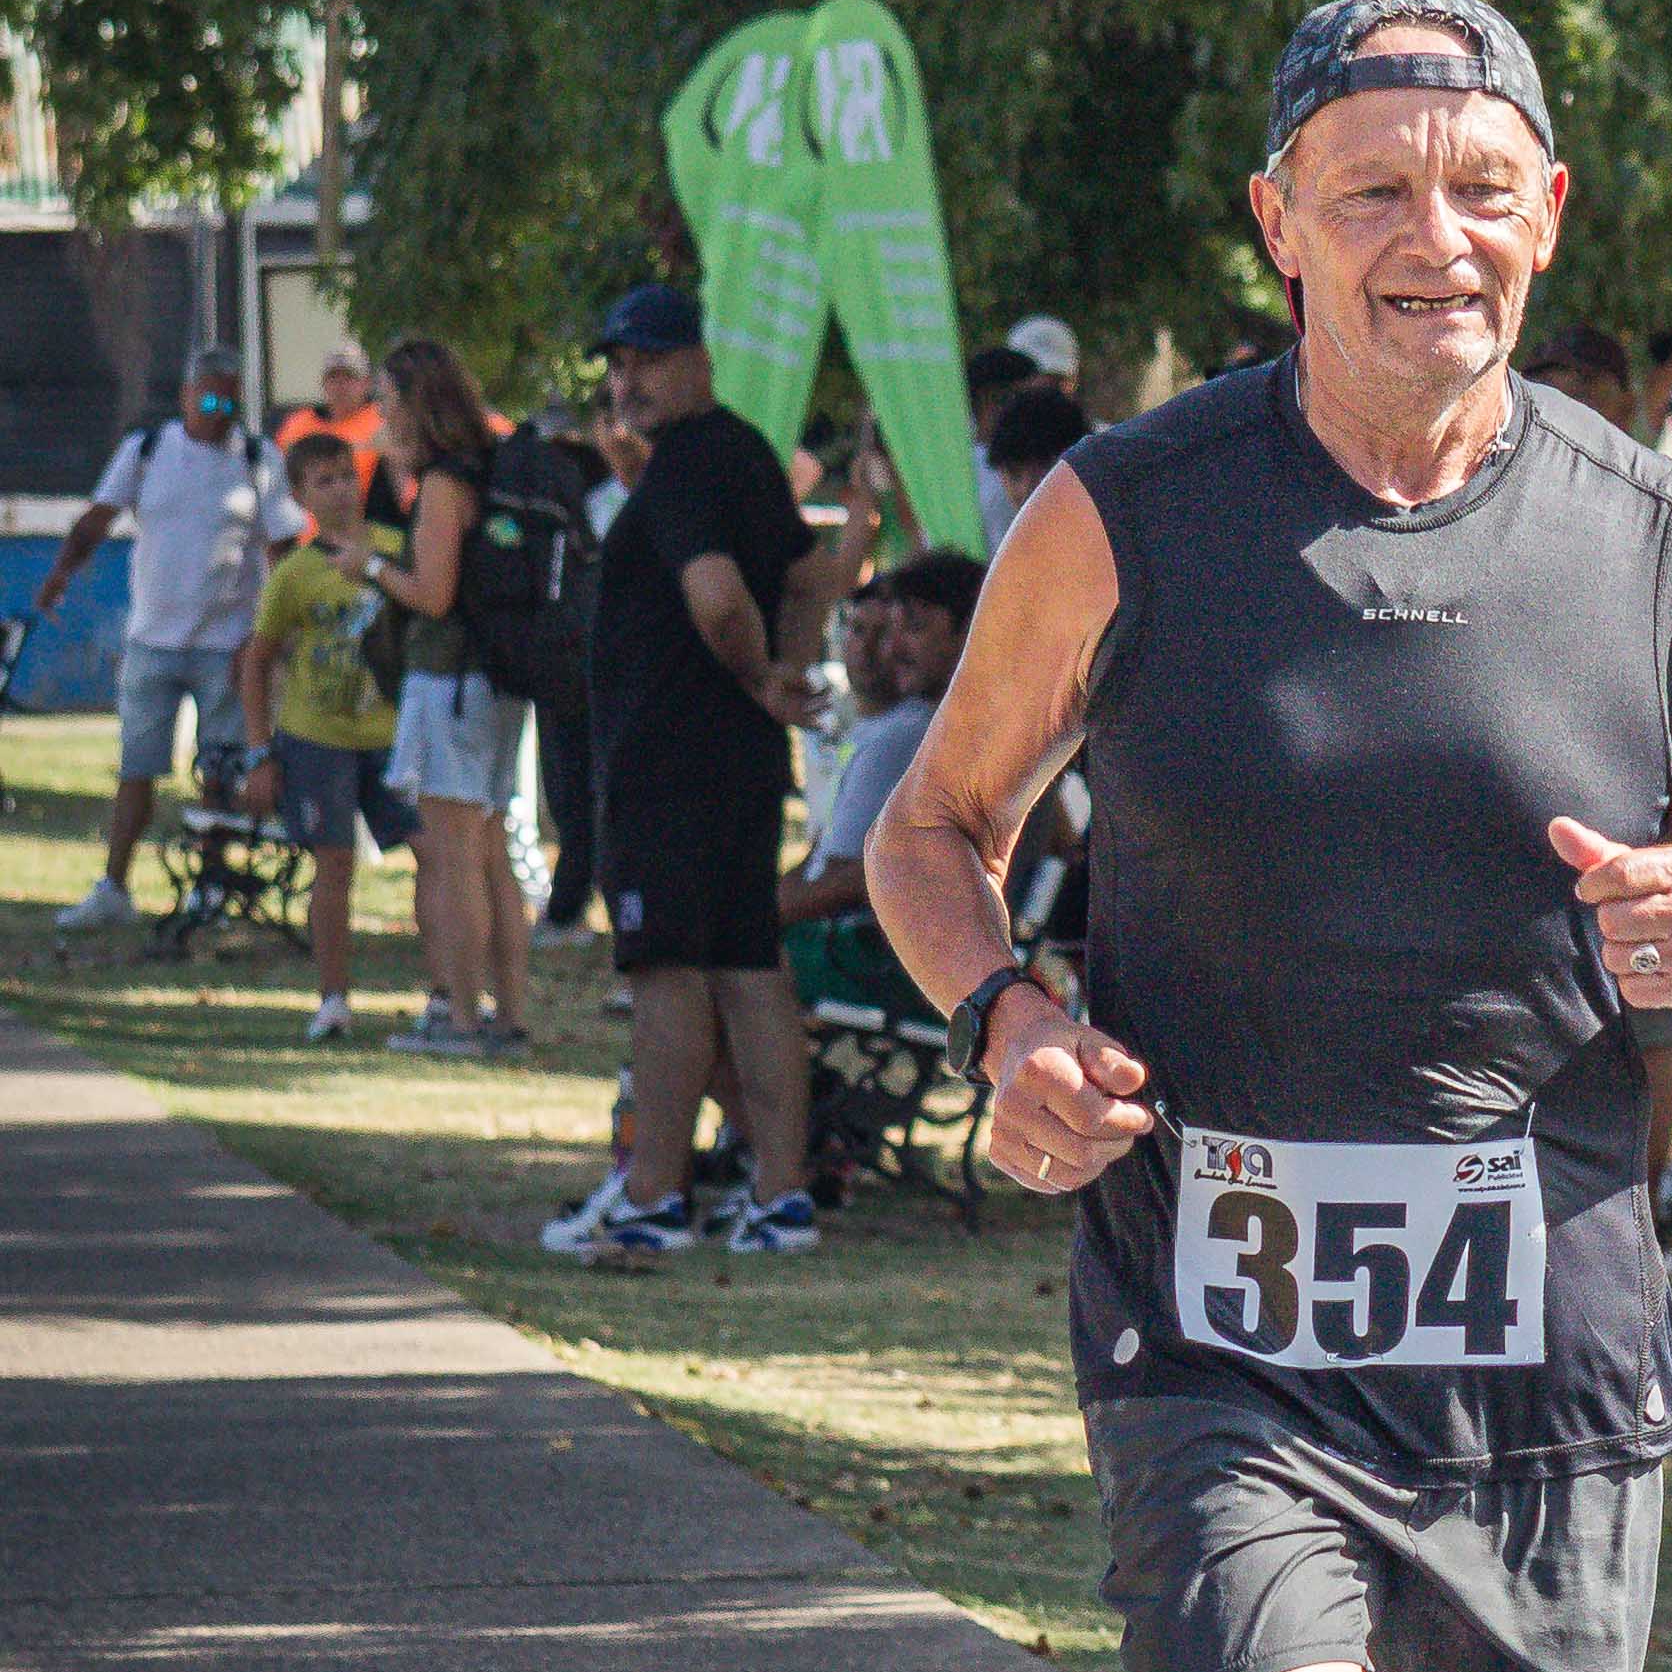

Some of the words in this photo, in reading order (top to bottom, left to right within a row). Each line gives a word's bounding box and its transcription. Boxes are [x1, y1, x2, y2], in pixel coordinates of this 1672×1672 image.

[1361, 607, 1469, 625] SCHNELL
[1487, 1150, 1522, 1173] sai
[1203, 1190, 1519, 1360] 354
